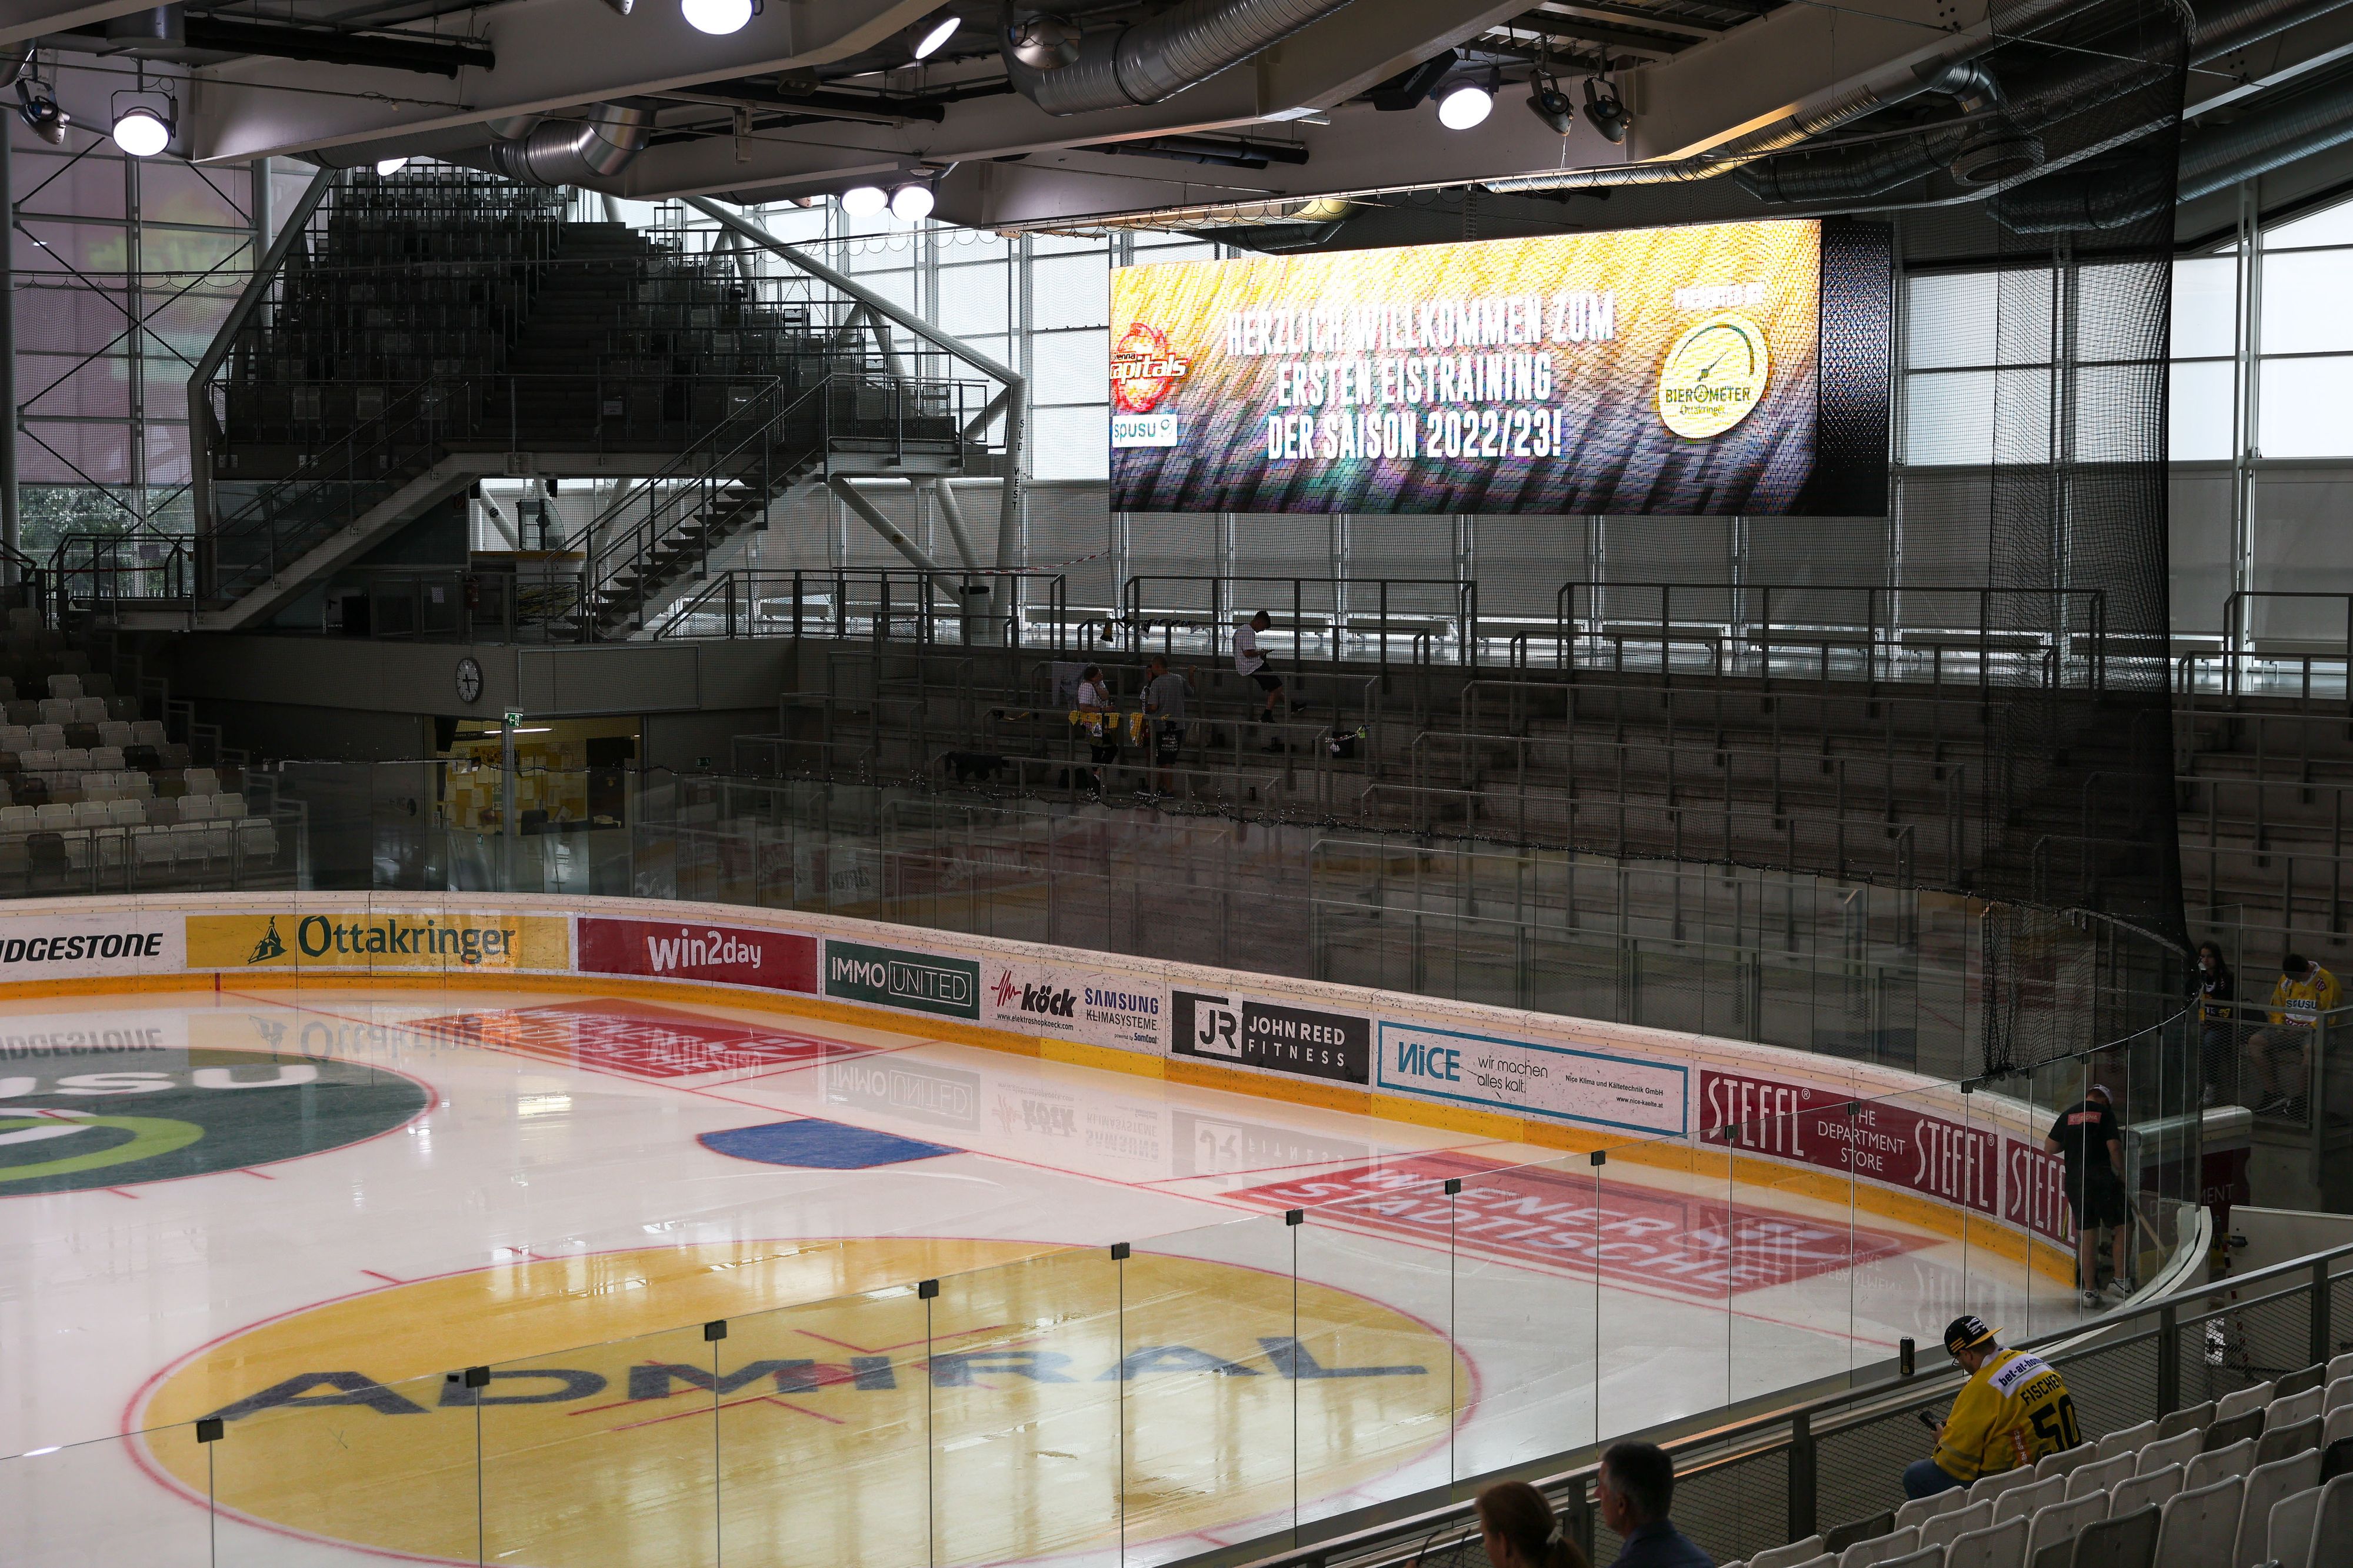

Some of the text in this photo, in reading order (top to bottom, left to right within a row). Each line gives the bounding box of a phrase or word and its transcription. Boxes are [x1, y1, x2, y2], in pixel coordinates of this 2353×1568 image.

[1227, 292, 1613, 355] HERZLICH WILLKOMMEN ZUM
[1278, 351, 1551, 406] ERSTEN EISTRAINING
[1114, 422, 1156, 443] spusu
[1268, 409, 1561, 459] DER SAISON 2022/23!
[0, 933, 164, 963] DGESTONE
[299, 915, 516, 965] Ottakringer
[832, 955, 968, 1001] IMMO UNITED
[1021, 983, 1077, 1018] köck
[1085, 987, 1159, 1015] SAMSUNG
[997, 1012, 1074, 1031] www.elektroshopkoeck.com
[1086, 1009, 1158, 1031] KLIMASYSTEME
[1198, 1009, 1237, 1050] JR
[1248, 1016, 1345, 1046] JOHN REED
[1248, 1038, 1345, 1067] FITNESS
[1477, 1056, 1548, 1079] wir machen
[1477, 1073, 1503, 1090] alles
[1565, 1075, 1578, 1083] Nice
[1579, 1077, 1595, 1086] Klima
[1608, 1082, 1644, 1093] Kältetechnik
[1645, 1087, 1664, 1096] GmbH
[1616, 1096, 1664, 1109] www.nice-kaelte.at
[1818, 1120, 1906, 1156] DEPARTMENT
[2029, 1393, 2082, 1454] 50
